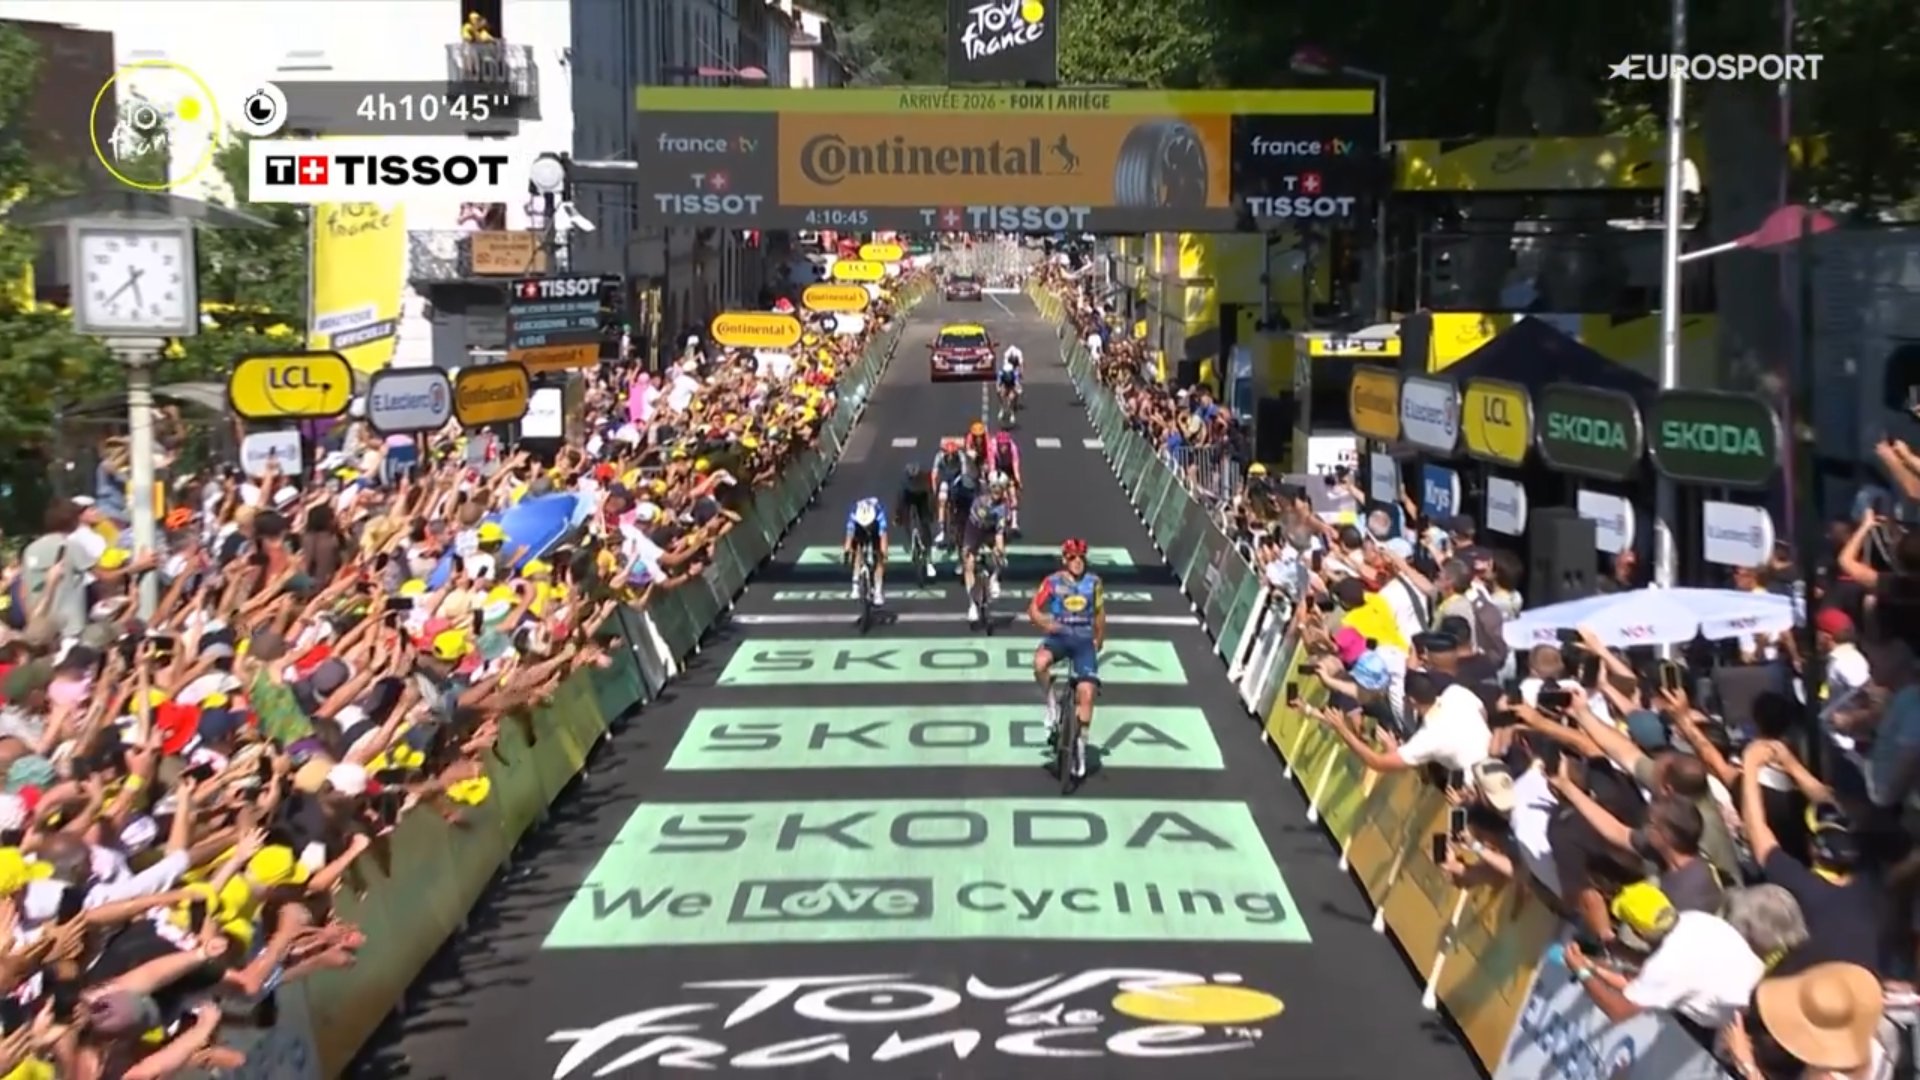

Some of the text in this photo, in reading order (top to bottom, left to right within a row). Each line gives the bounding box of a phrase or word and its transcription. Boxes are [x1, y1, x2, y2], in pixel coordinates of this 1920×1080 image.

[961, 22, 1044, 60] france
[963, 93, 997, 110] 2026
[1010, 93, 1044, 110] FOIX
[657, 133, 728, 154] france
[1251, 134, 1322, 156] france
[801, 134, 1042, 186] Continental
[654, 193, 763, 216] TISSOT
[1246, 196, 1356, 218] TISSOT
[805, 210, 869, 226] 4:10:45
[966, 205, 1092, 231] TISSOT
[539, 278, 601, 298] TISSOT
[716, 321, 786, 336] Continental
[269, 366, 318, 389] LCL
[1483, 395, 1512, 428] LCL
[1548, 411, 1628, 450] SKODA
[1661, 420, 1766, 457] SKODA
[649, 809, 1238, 854] SKODA
[592, 880, 1287, 925] We Love Cycling
[547, 1002, 1255, 1080] france
